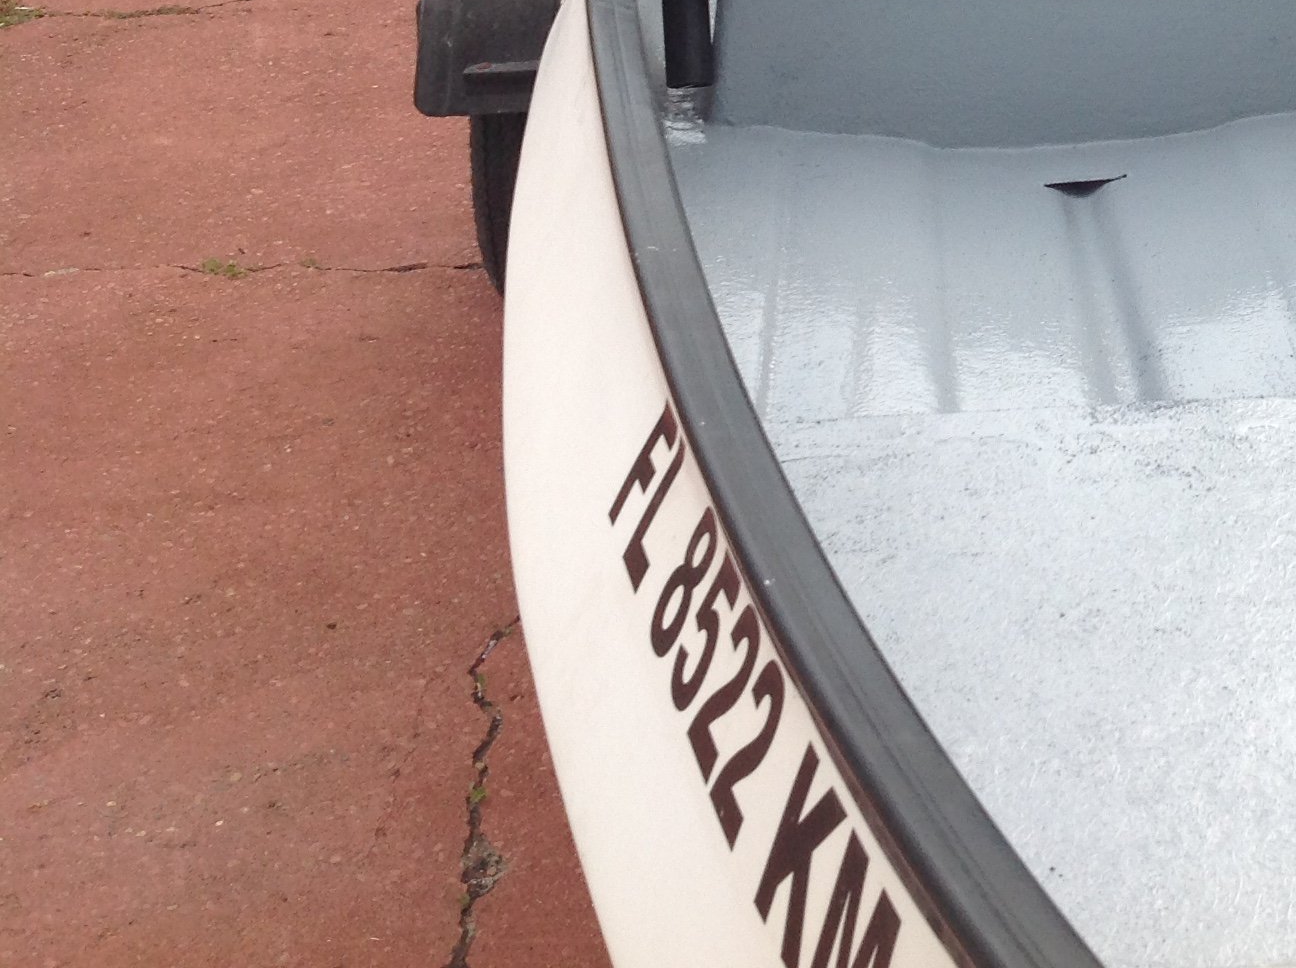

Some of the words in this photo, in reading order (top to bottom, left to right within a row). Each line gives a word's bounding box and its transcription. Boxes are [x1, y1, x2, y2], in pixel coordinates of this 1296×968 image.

[608, 396, 686, 595] FL
[650, 505, 786, 853] 8522
[754, 741, 902, 968] KM
